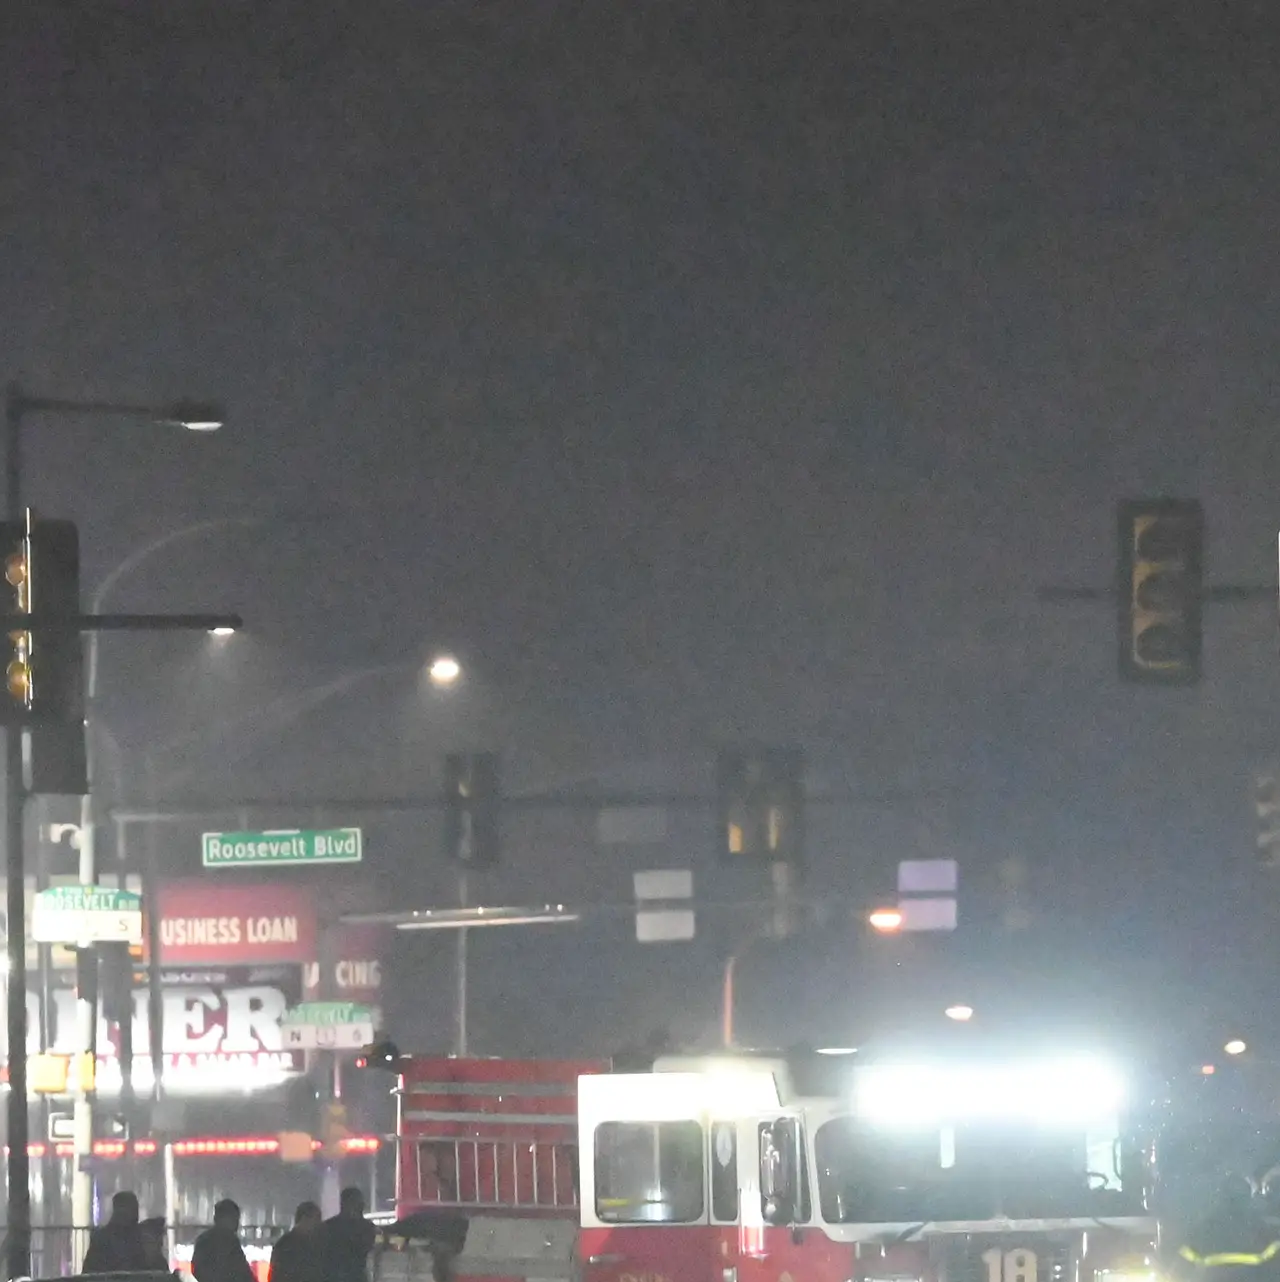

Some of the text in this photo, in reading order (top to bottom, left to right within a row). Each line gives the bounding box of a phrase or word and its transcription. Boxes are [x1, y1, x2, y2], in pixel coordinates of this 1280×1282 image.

[208, 834, 357, 860] Roosevelt Blvd
[160, 915, 298, 945] USINESS LOAN
[290, 1031, 301, 1042] N
